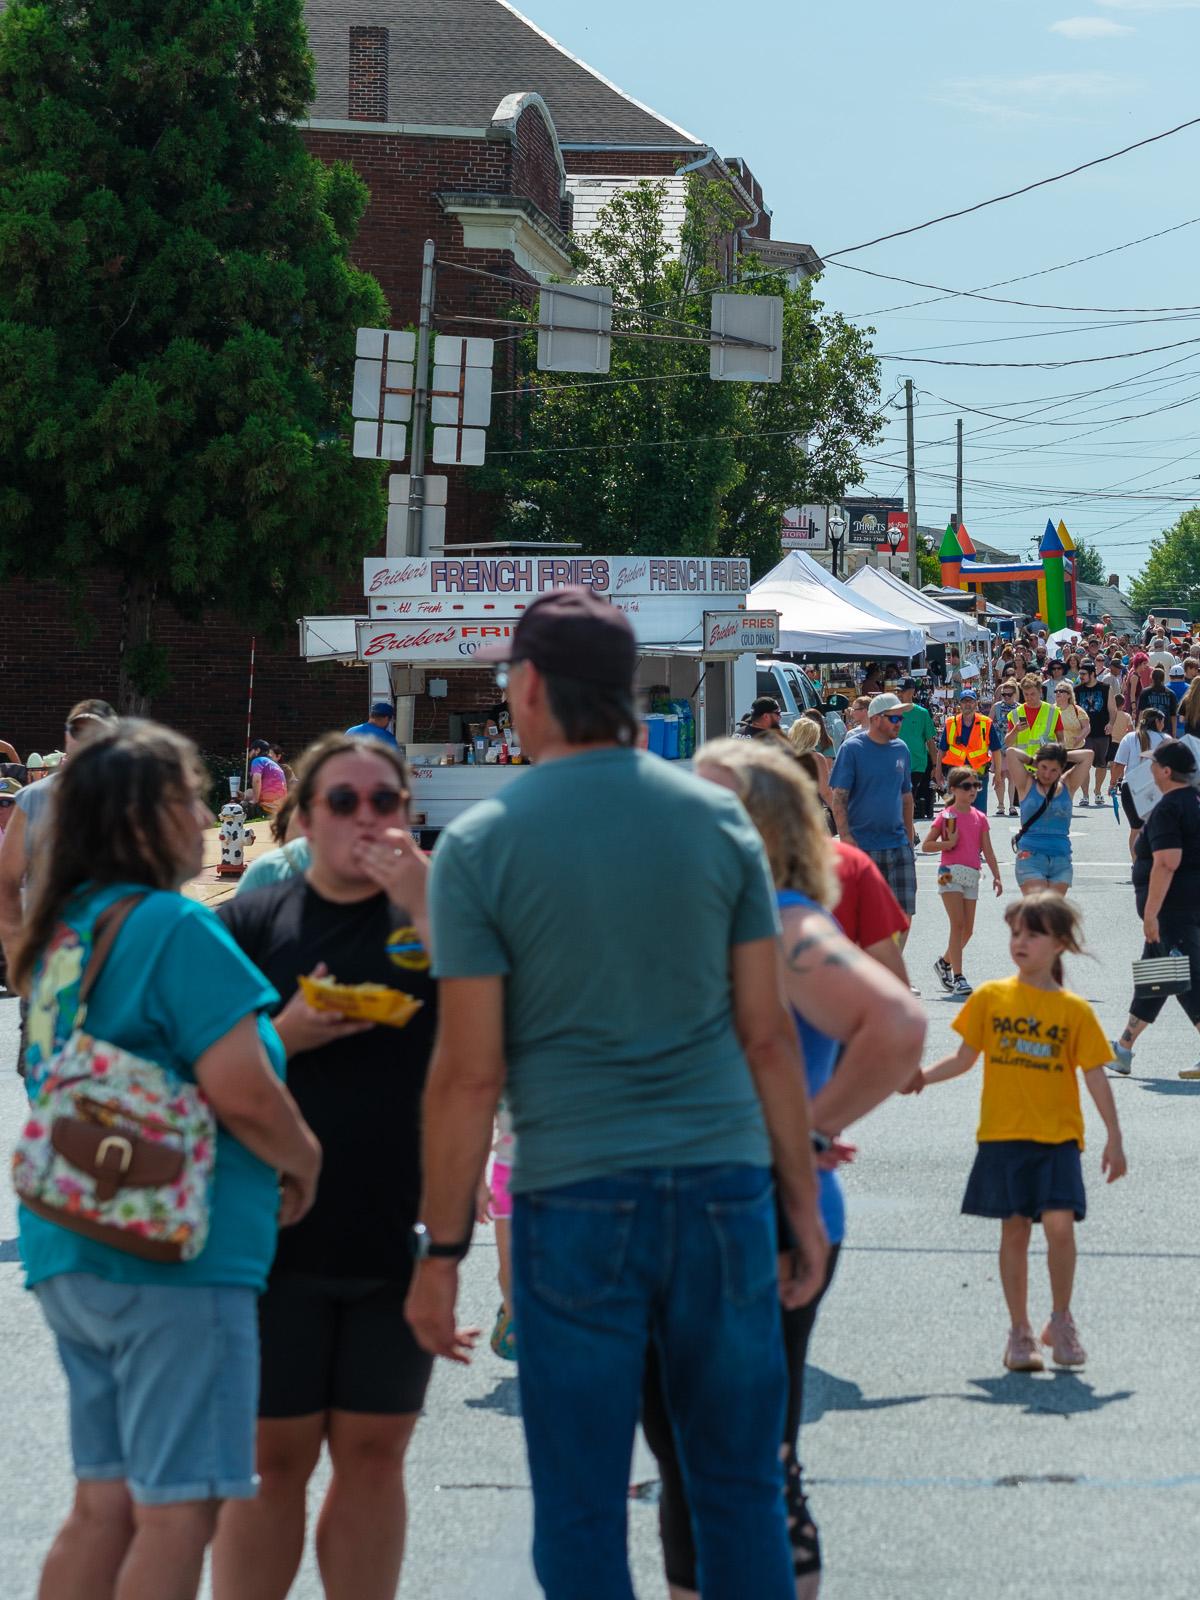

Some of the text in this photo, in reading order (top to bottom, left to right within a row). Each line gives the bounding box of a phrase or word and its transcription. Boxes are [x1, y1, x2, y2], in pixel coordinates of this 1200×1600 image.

[853, 519, 886, 532] THRIFTS
[368, 559, 610, 593] Bricker's FRENCH FRIES
[615, 559, 748, 592] Bricker's FRENCH FRIES
[709, 620, 739, 646] Bricker's
[742, 618, 775, 629] FRIES
[363, 625, 456, 657] Bricker's
[741, 632, 775, 646] COLD DRINKS
[992, 1015, 1042, 1038] PACK
